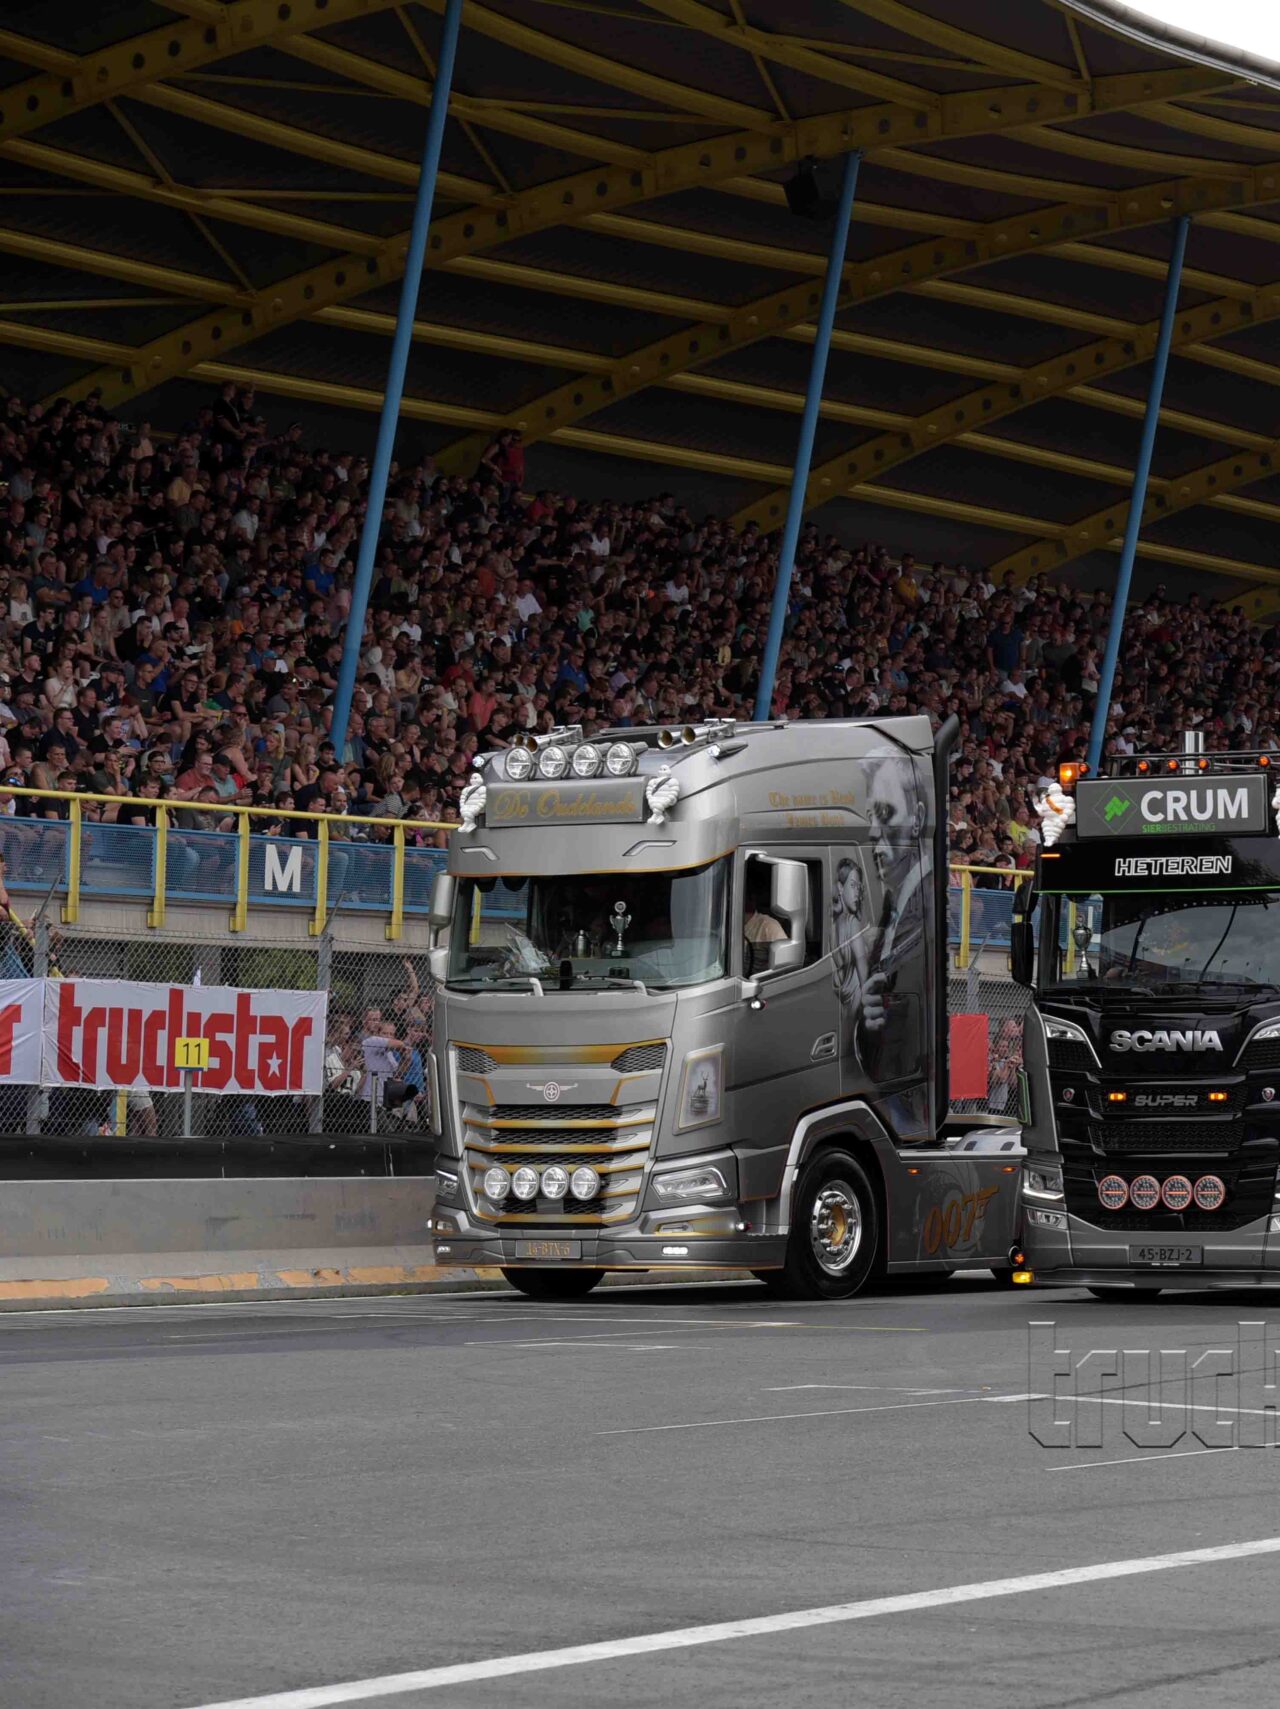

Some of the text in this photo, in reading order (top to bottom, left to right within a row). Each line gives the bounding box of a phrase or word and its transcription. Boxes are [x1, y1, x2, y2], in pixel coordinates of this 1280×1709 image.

[1140, 788, 1249, 822] CRUM
[1142, 823, 1216, 833] SIERBESTRATING
[264, 843, 303, 892] M
[1114, 856, 1233, 876] HETEREN
[1109, 1030, 1224, 1052] SCANIA
[182, 1042, 202, 1066] 11
[1134, 1095, 1198, 1107] SUPER
[924, 1194, 978, 1255] 007
